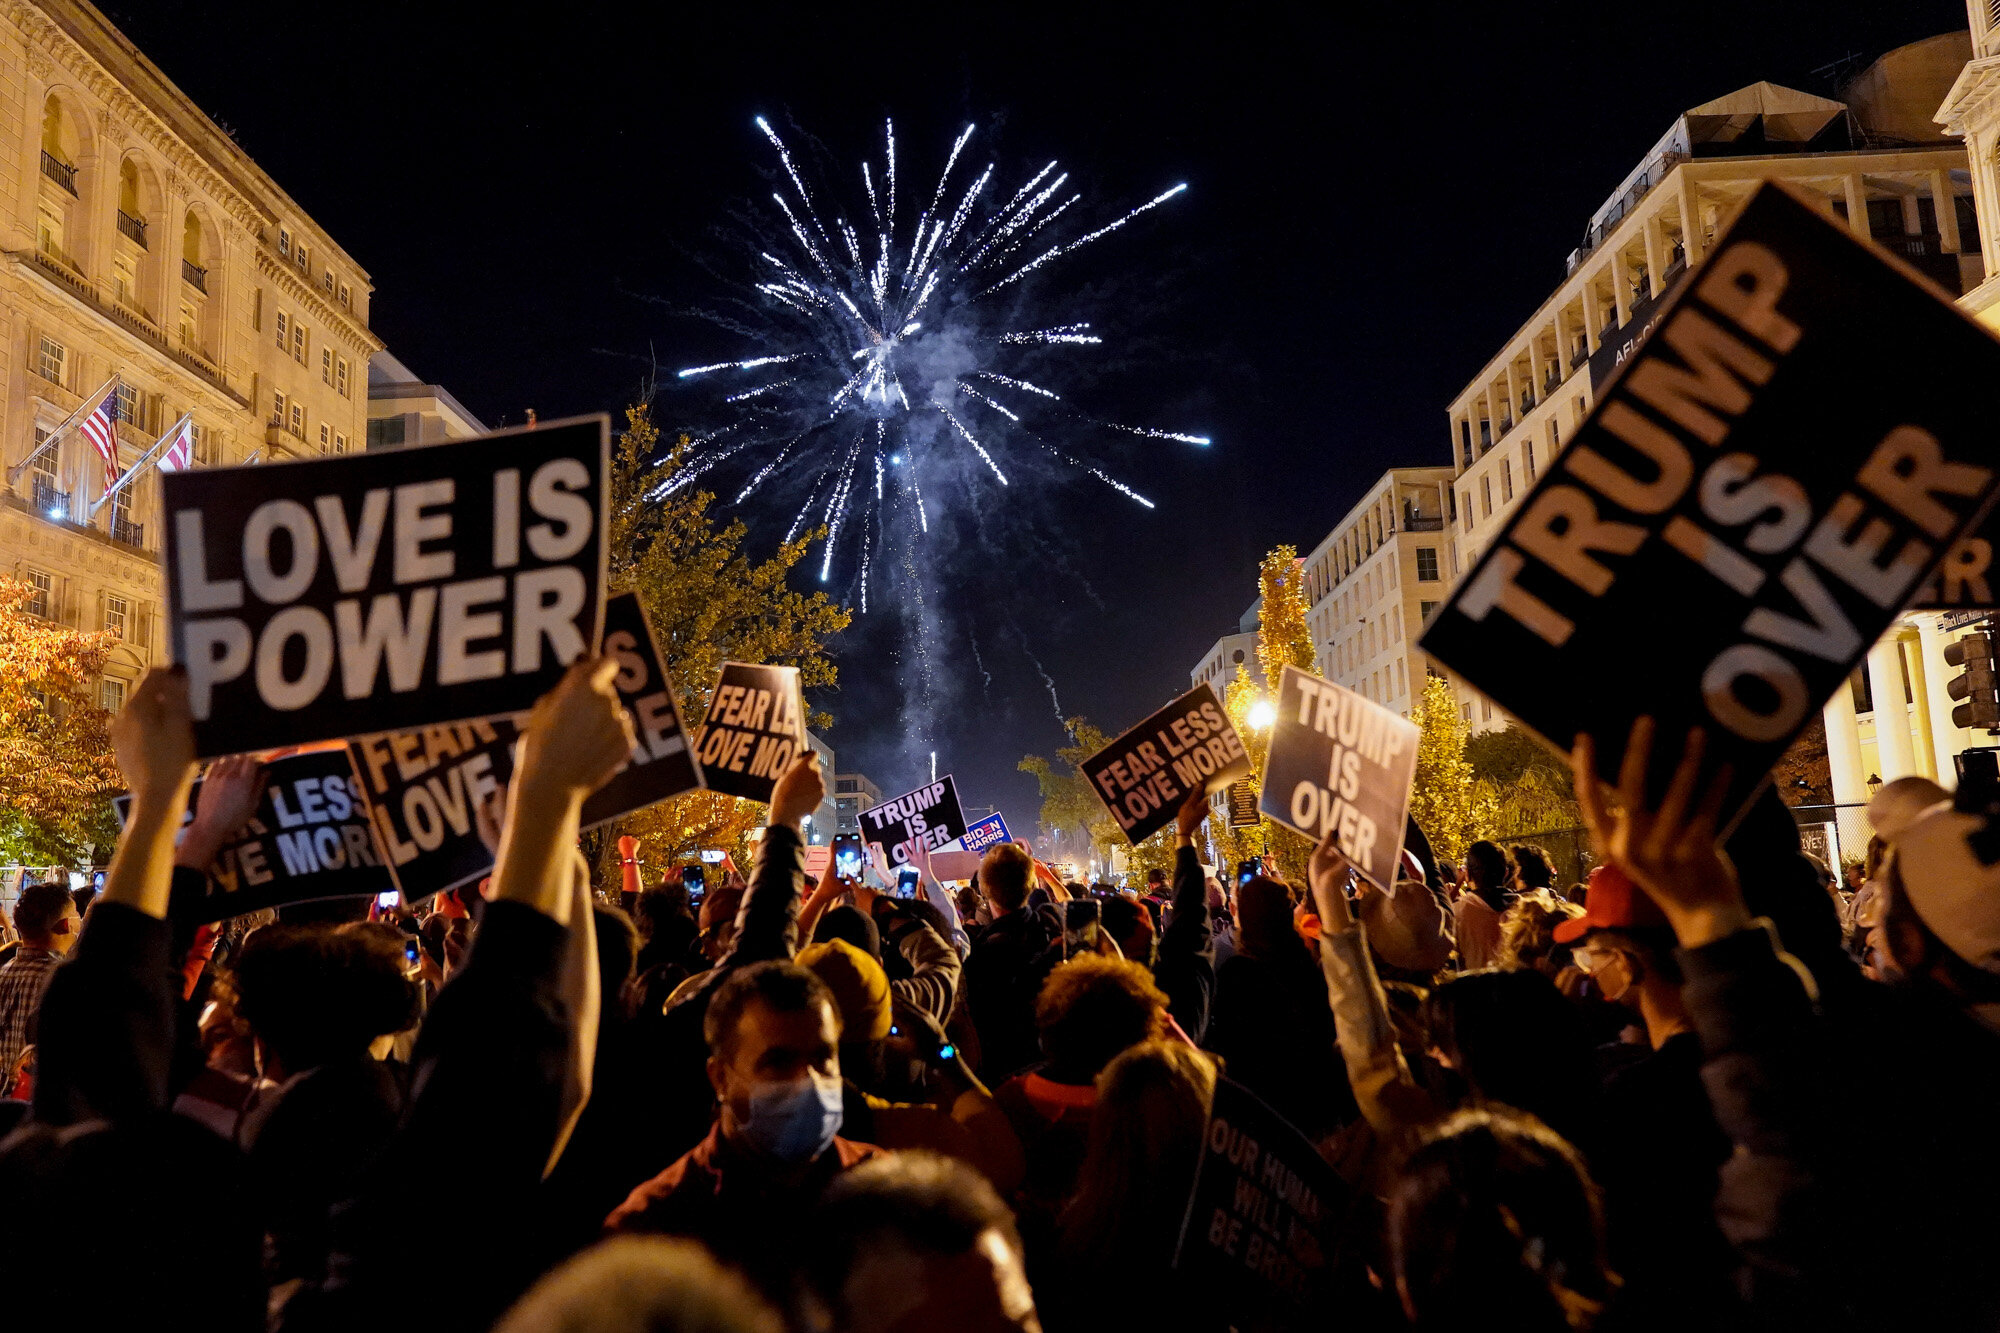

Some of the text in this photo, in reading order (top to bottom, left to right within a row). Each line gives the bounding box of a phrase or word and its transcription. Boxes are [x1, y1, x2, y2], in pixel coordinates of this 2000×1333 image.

[1455, 241, 1802, 648] TRUMP
[174, 457, 594, 611] LOVE IS
[1662, 452, 1813, 597] IS
[1702, 423, 1999, 743] OVER
[182, 564, 588, 721] POWER
[709, 684, 771, 731] FEAR
[768, 690, 797, 735] LE
[1296, 677, 1401, 770] TRUMP
[692, 724, 756, 773] LOVE
[1096, 741, 1166, 800] FEAR
[1157, 701, 1225, 759] LESS
[1328, 744, 1361, 802] IS
[373, 752, 497, 868] LOVE
[868, 781, 945, 830] TRUMP
[1110, 770, 1179, 831] LOVE
[1175, 729, 1245, 789] MORE
[891, 824, 951, 864] OVER
[903, 813, 928, 838] IS
[963, 820, 1001, 844] BIDEN
[967, 829, 1004, 851] HARRIS
[1291, 781, 1377, 872] OVER
[204, 840, 275, 898] VE
[1210, 1118, 1259, 1177] OUR
[1209, 1207, 1243, 1257] BE
[1234, 1176, 1281, 1242] WILL
